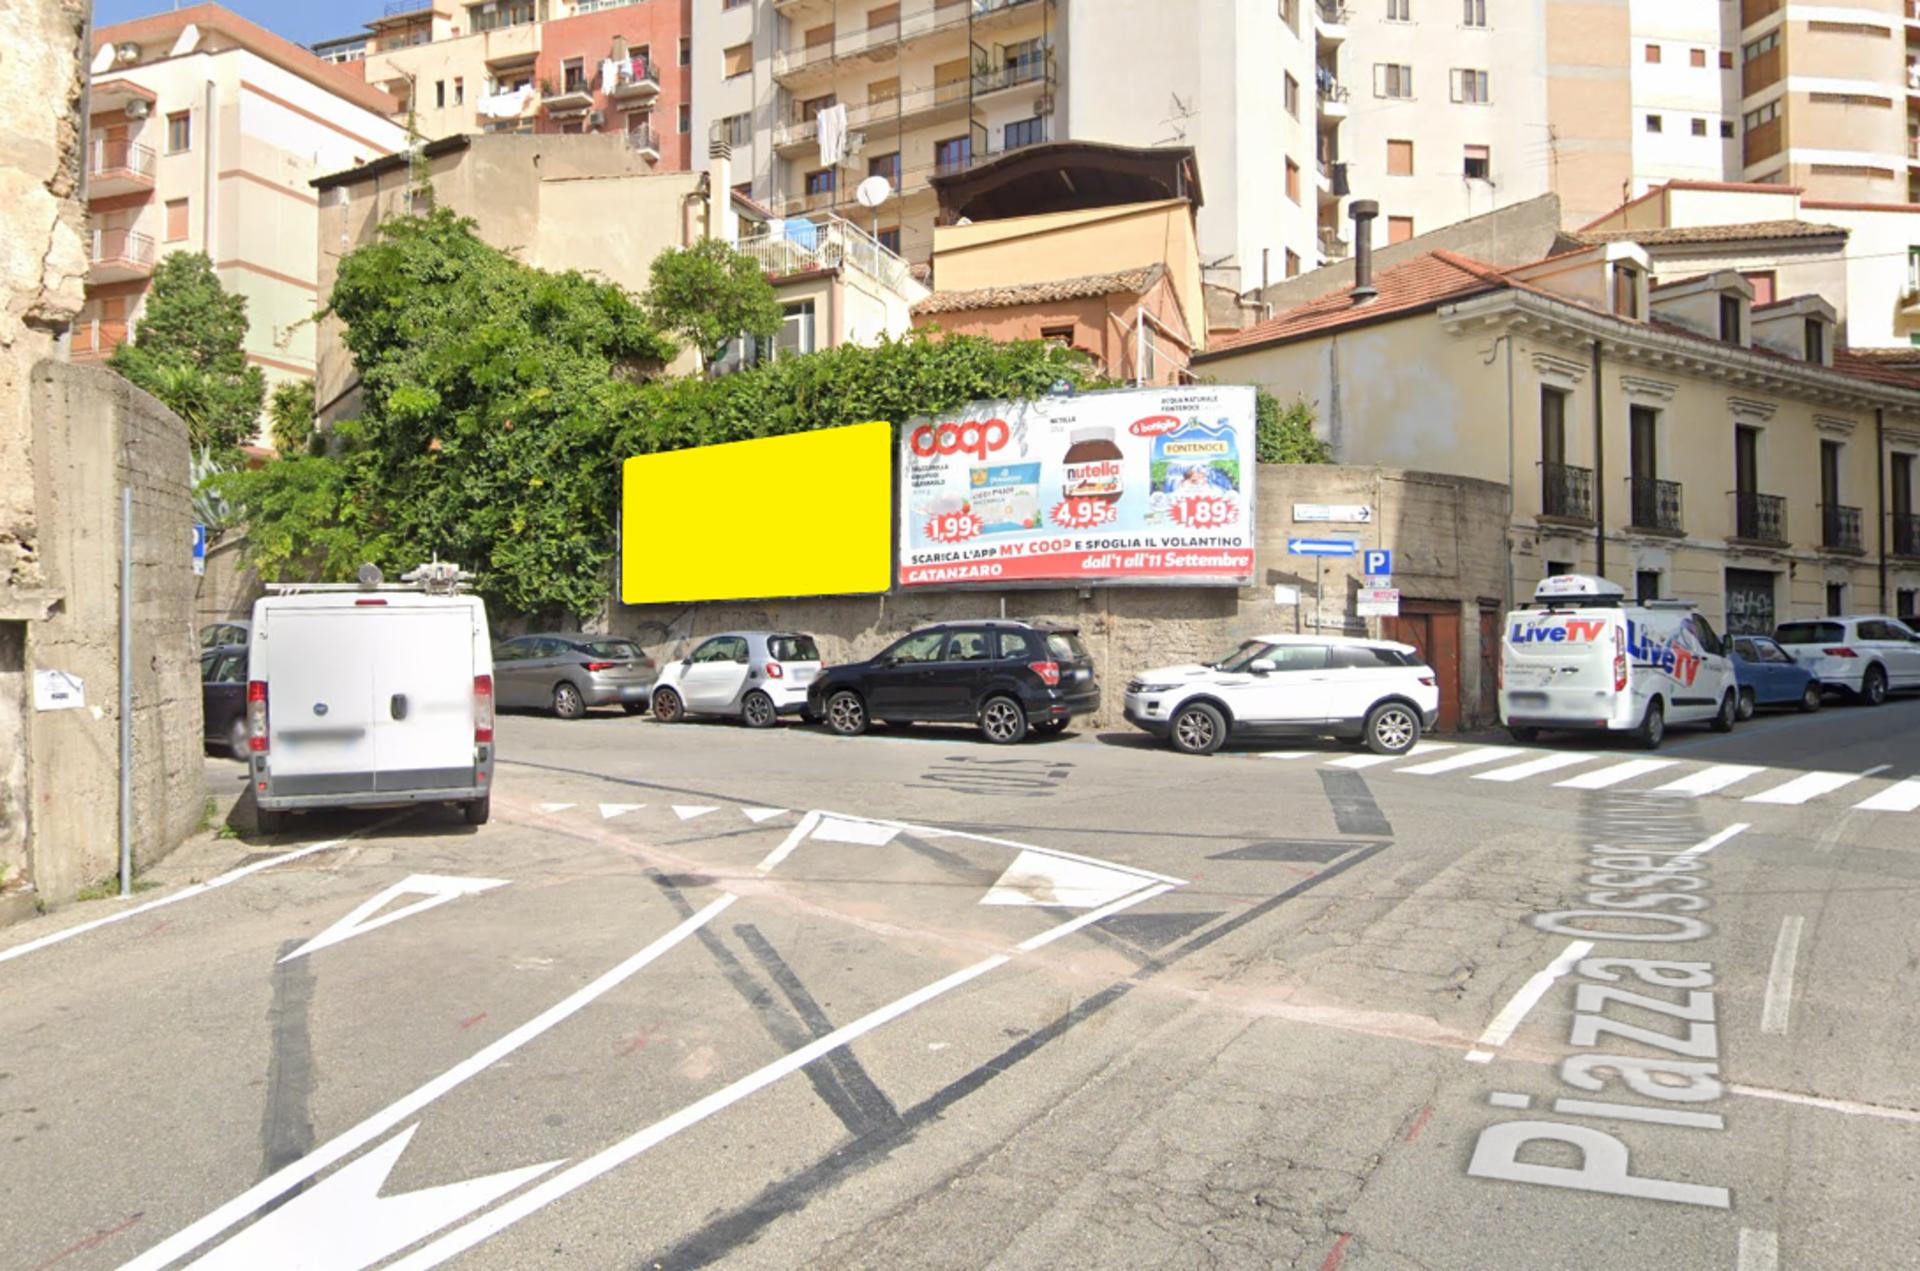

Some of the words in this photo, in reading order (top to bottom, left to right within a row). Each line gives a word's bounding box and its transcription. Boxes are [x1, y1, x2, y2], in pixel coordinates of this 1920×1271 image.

[910, 418, 1009, 461] coop
[1166, 442, 1226, 454] FONTENOCE
[1067, 461, 1119, 480] nutella
[1057, 501, 1117, 525] 4,95€
[911, 552, 960, 565] SCARICA
[963, 549, 997, 560] L'APP
[1000, 543, 1024, 556] MY
[1029, 539, 1071, 553] COOP
[1075, 541, 1082, 550] E
[1086, 538, 1141, 549] SFOGLIA
[1145, 537, 1157, 547] IL
[1161, 536, 1242, 548] VOLANTINO
[1165, 552, 1249, 568] Settembre
[1369, 552, 1386, 574] P
[909, 564, 1002, 583] CATANZARO
